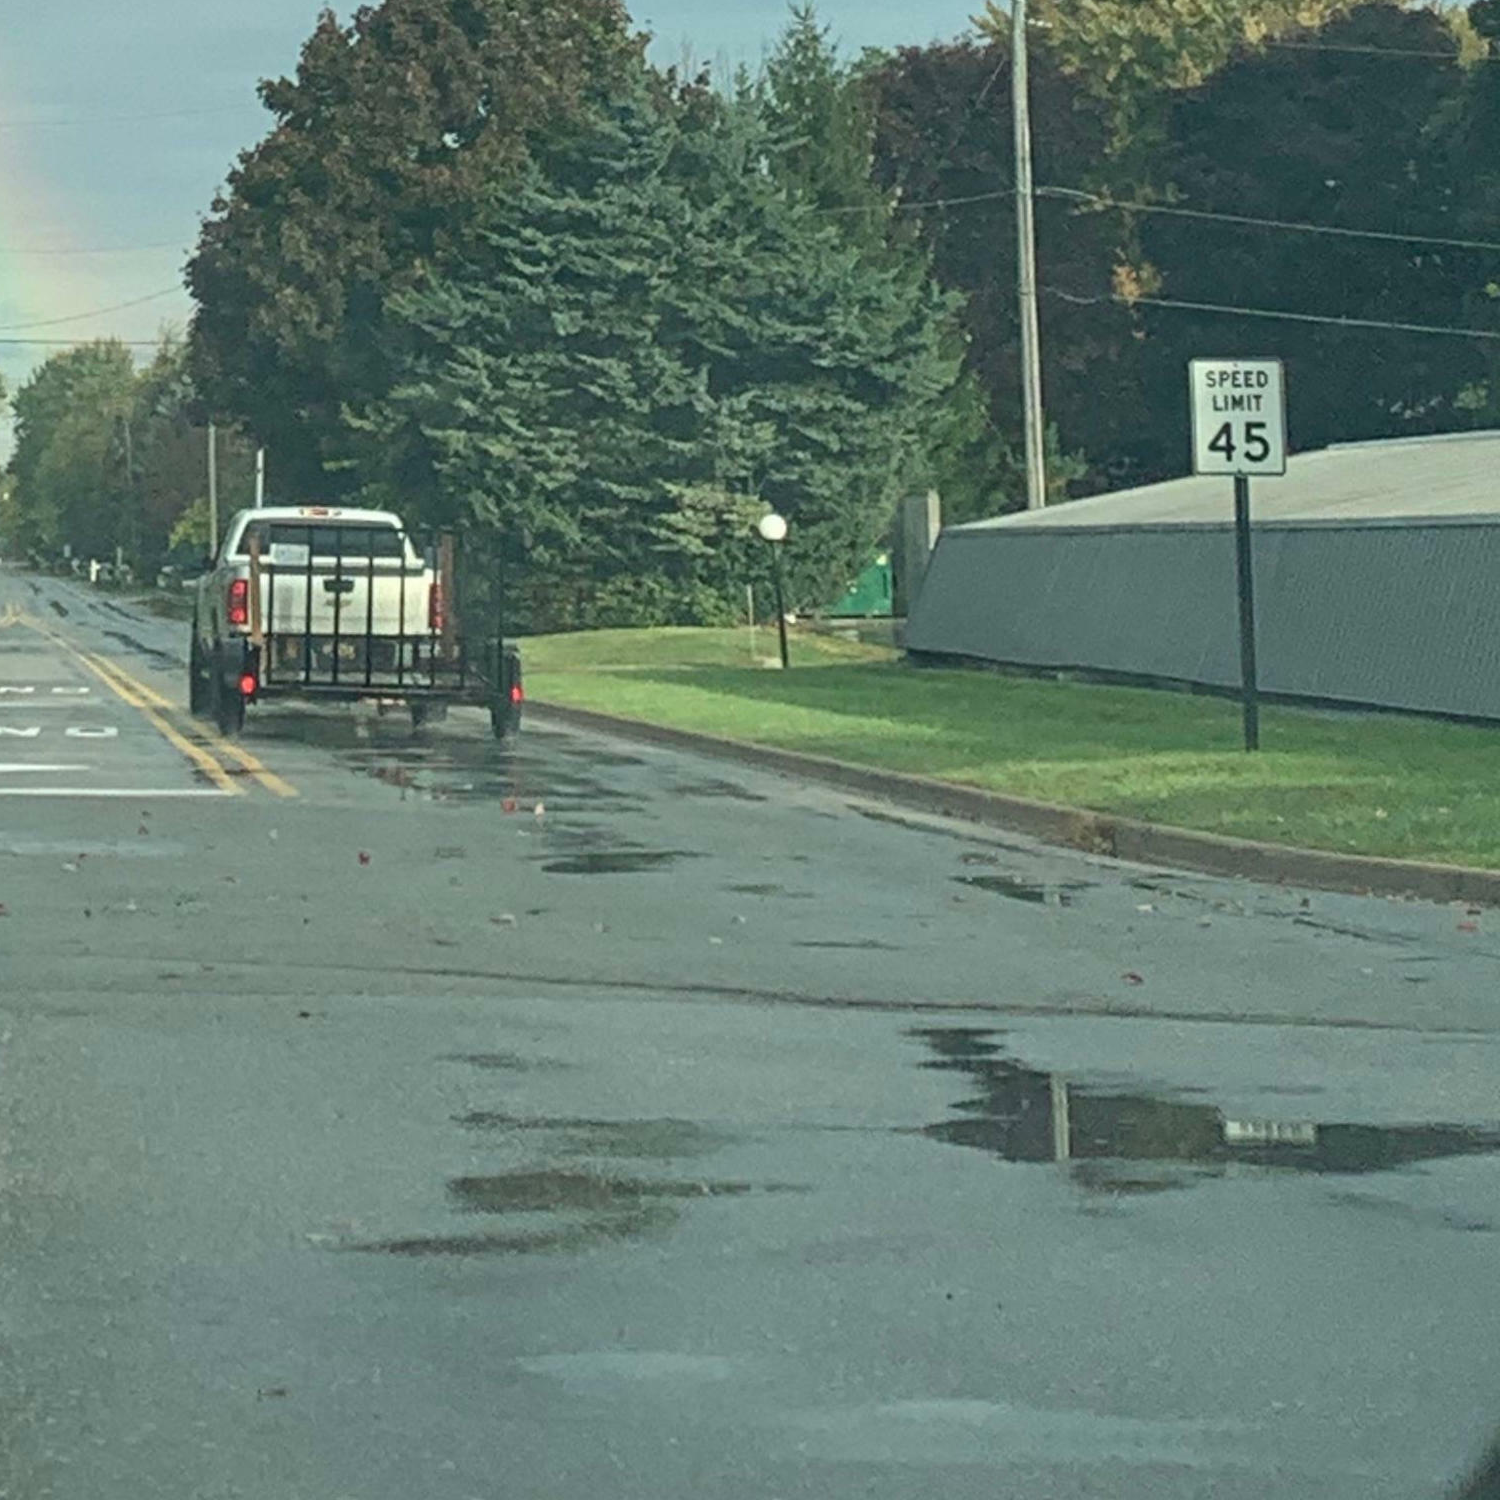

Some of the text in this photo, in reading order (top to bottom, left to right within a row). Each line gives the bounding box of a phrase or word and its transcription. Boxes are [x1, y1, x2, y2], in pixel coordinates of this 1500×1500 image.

[1205, 370, 1268, 388] SPEED
[1212, 394, 1263, 412] LIMIT
[1208, 422, 1270, 463] 45
